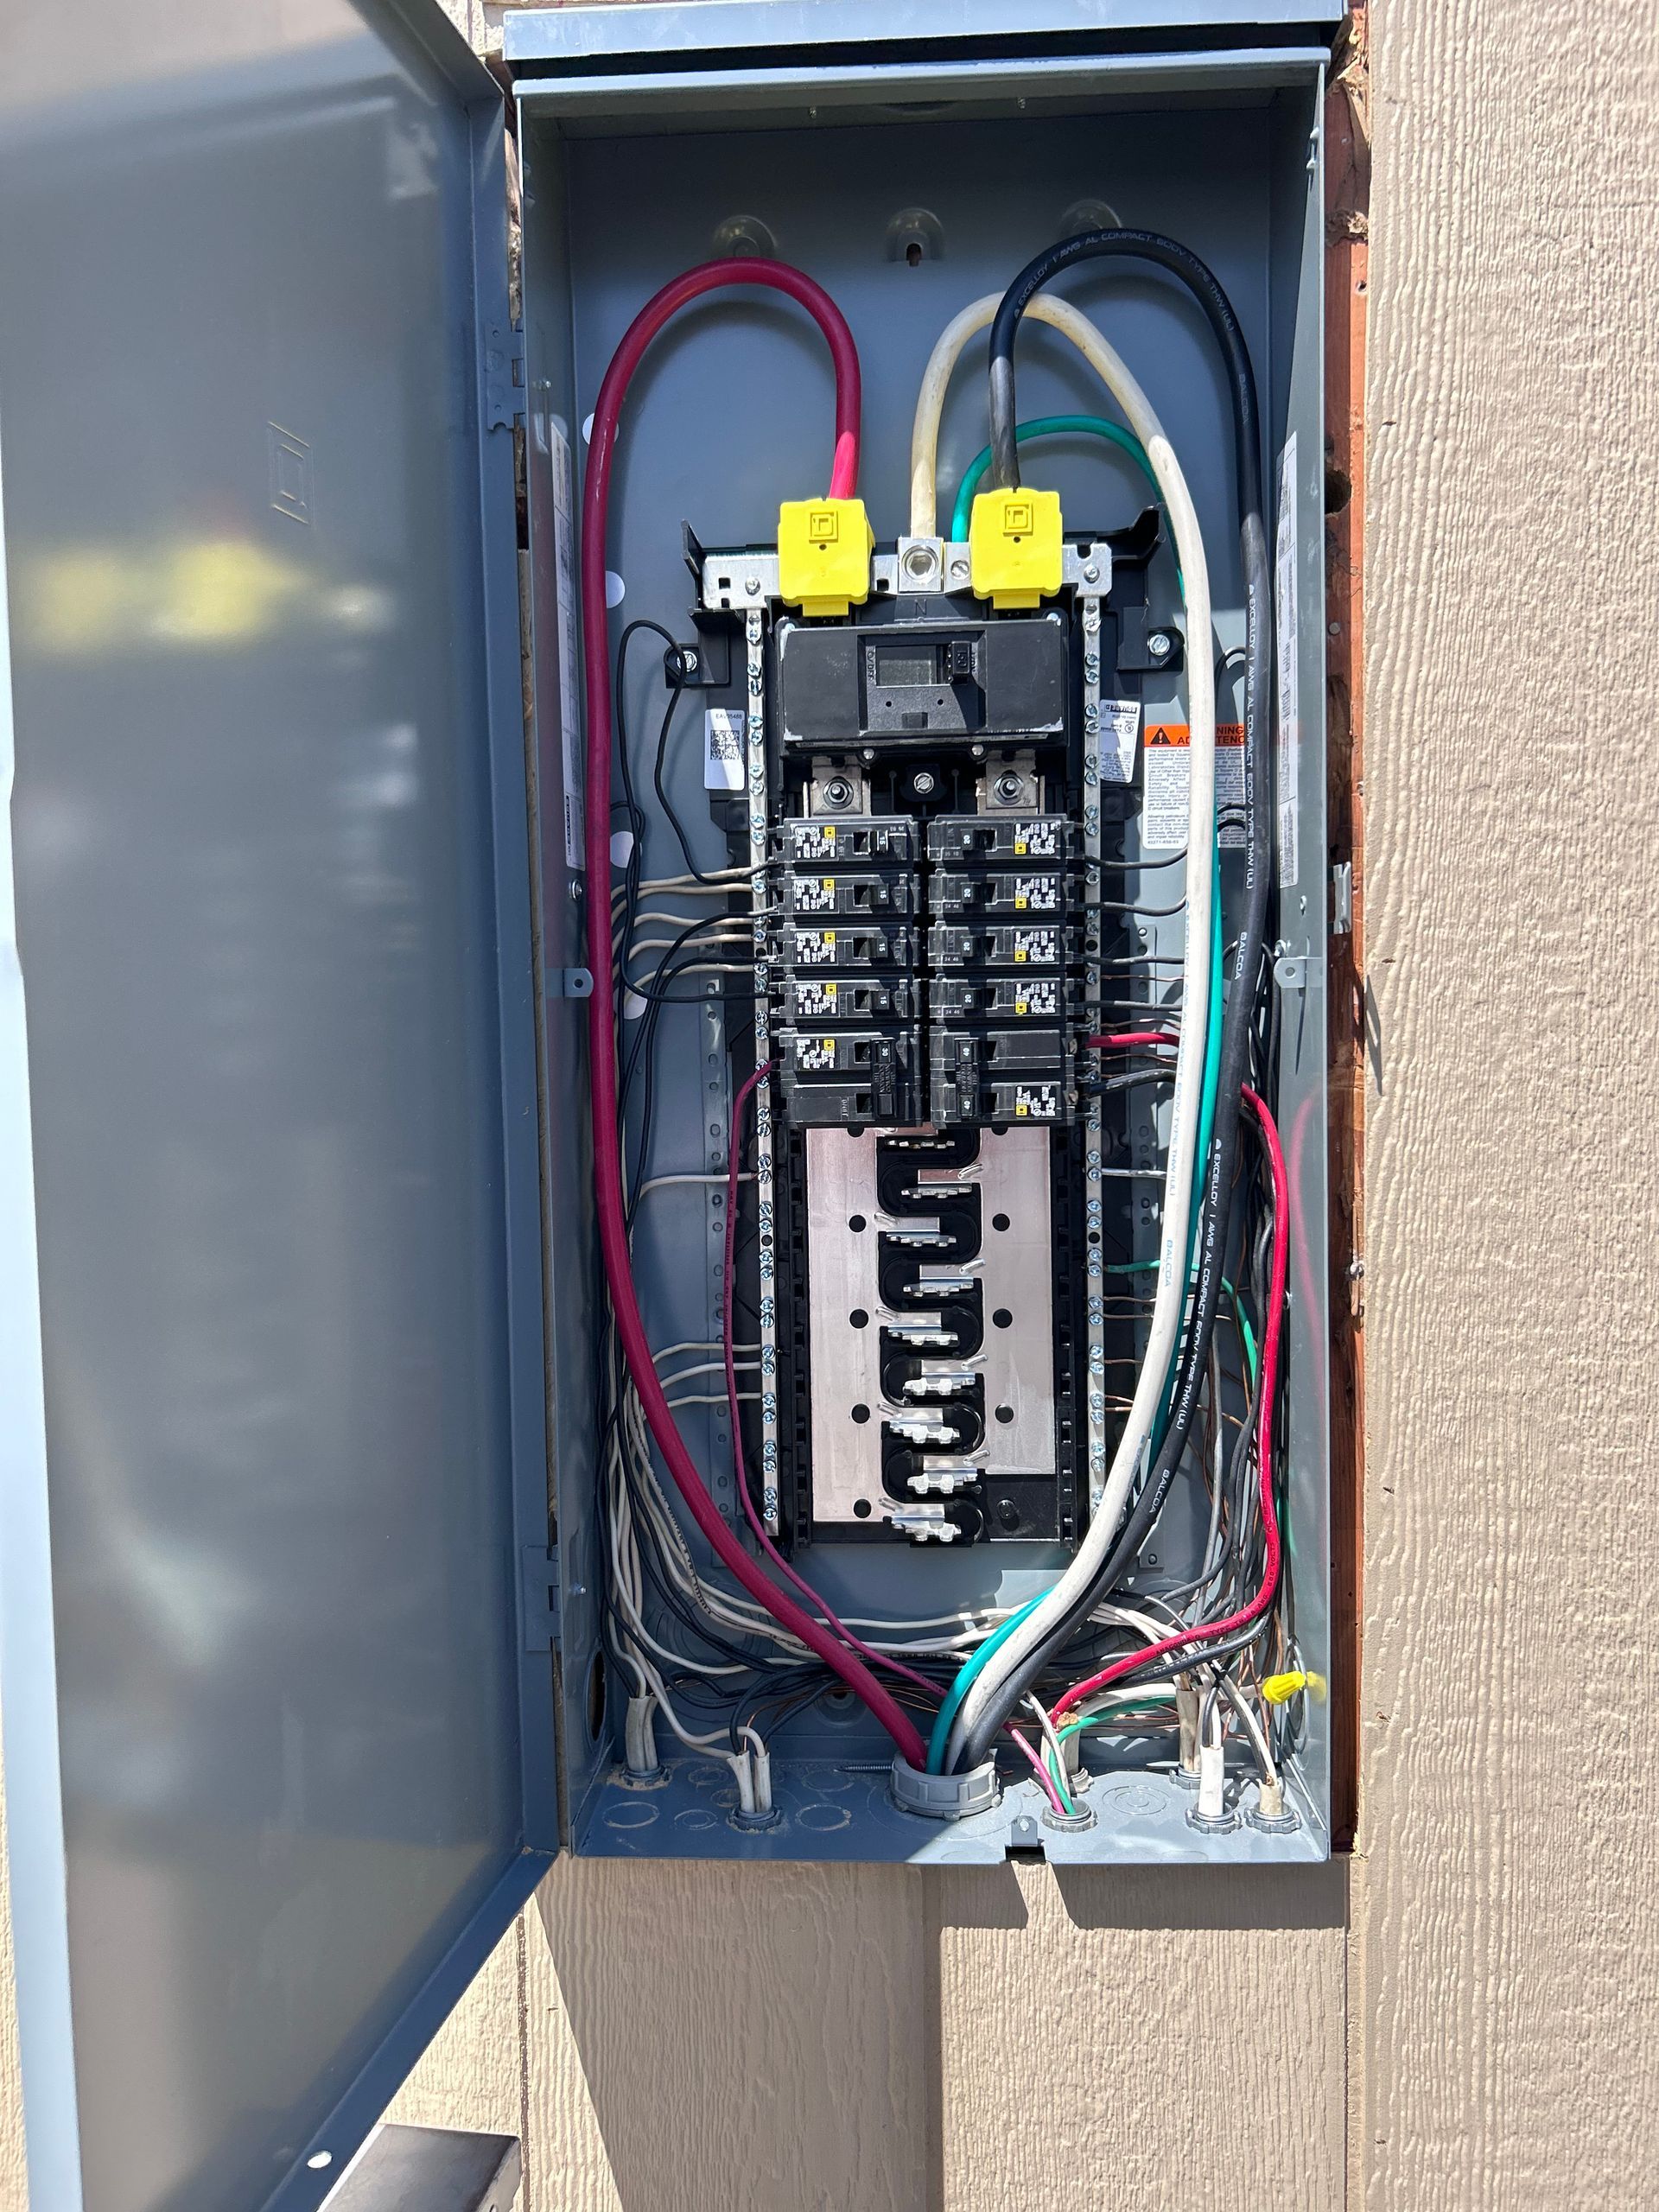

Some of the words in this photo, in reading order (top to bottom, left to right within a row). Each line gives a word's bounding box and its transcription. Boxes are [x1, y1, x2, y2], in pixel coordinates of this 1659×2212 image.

[1085, 236, 1098, 245] AL
[1101, 232, 1152, 242] COMPACT
[1248, 667, 1256, 691] AWG
[1247, 696, 1255, 711] AL
[1246, 715, 1255, 767] COMPACT
[879, 836, 886, 846] 15
[880, 889, 887, 899] 15
[963, 888, 971, 898] 20
[879, 943, 886, 952] 15
[963, 942, 970, 951] 20
[880, 995, 887, 1005] 15
[964, 994, 972, 1003] 20
[880, 1048, 888, 1057] 30
[963, 1047, 970, 1057] 40
[963, 1100, 971, 1109] 40
[1211, 1153, 1221, 1207] EXCELLOY
[1206, 1221, 1216, 1247] AWG
[1204, 1250, 1211, 1264] AL
[1198, 1268, 1211, 1317] COMPACT
[1188, 1353, 1198, 1382] TYPE
[1181, 1384, 1192, 1408] THW
[1175, 1409, 1187, 1430] (UL)
[1148, 1476, 1167, 1513] ALCOA
